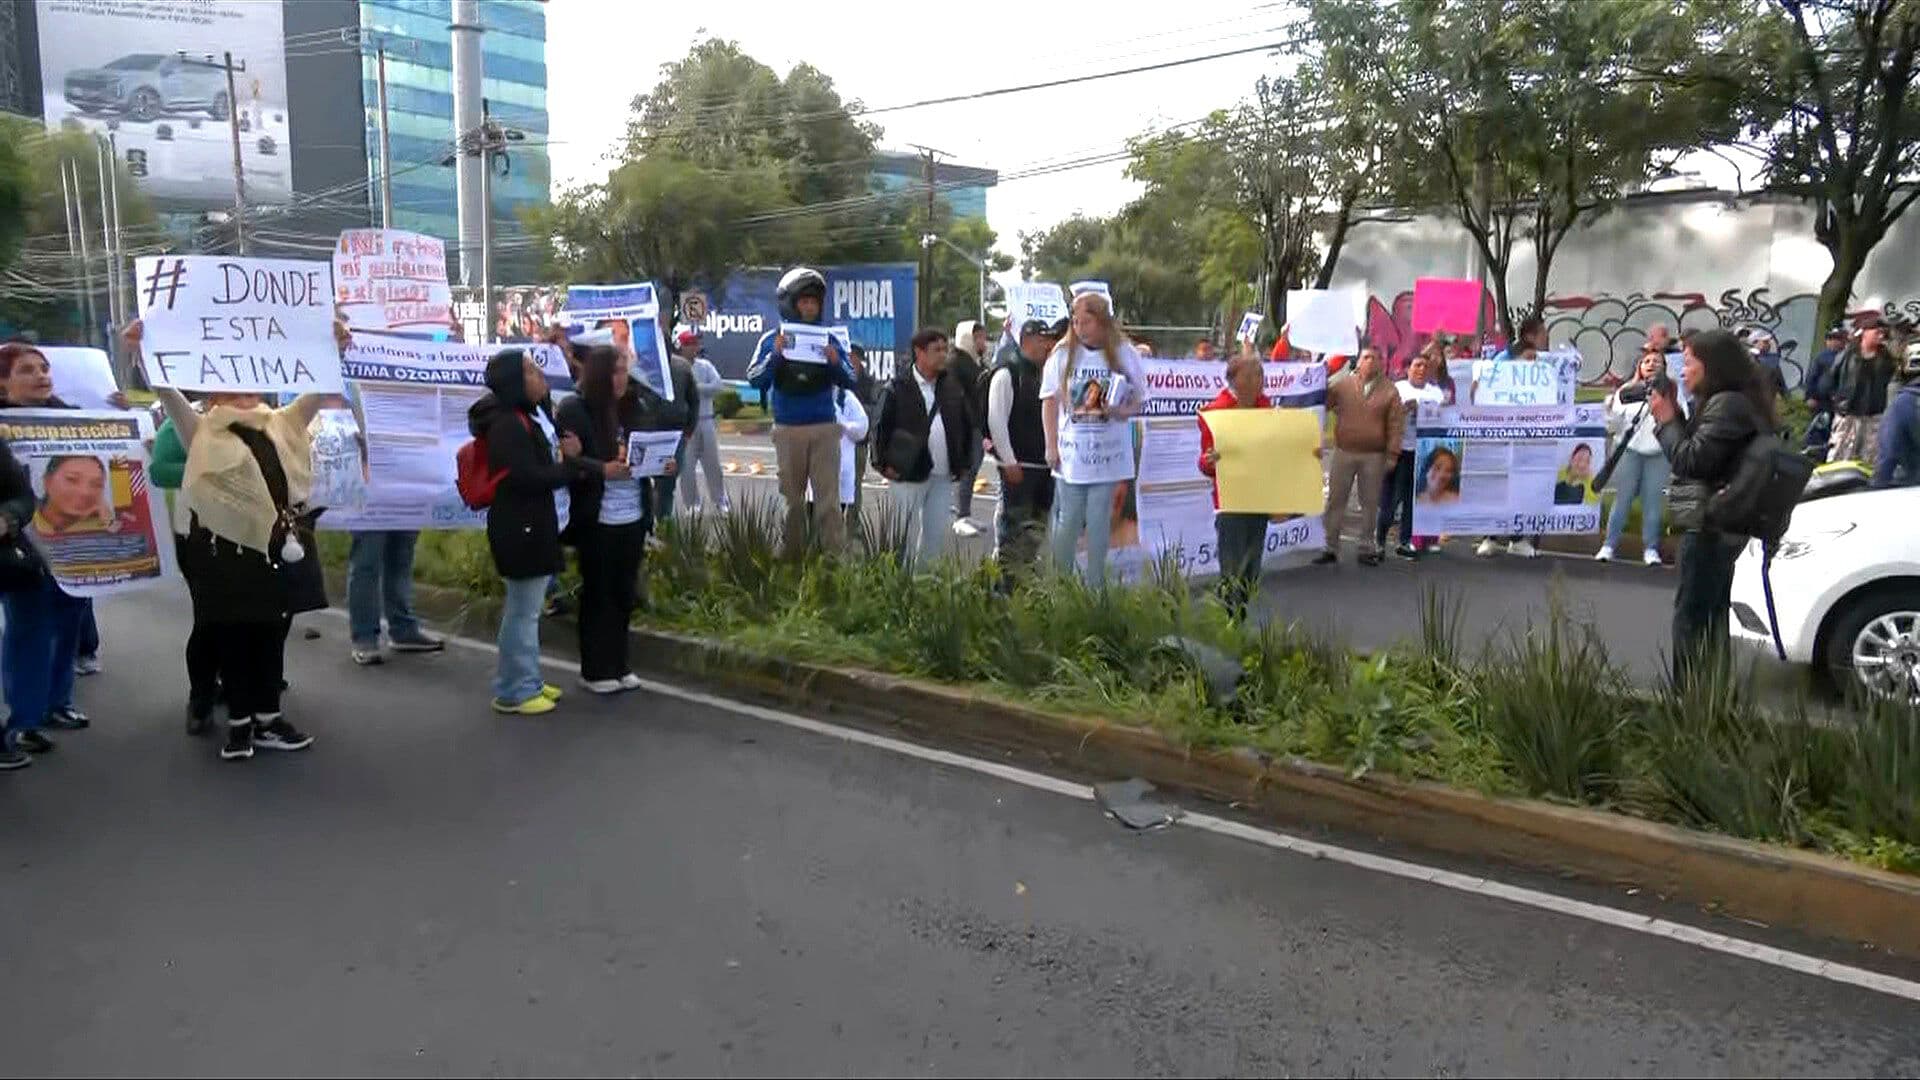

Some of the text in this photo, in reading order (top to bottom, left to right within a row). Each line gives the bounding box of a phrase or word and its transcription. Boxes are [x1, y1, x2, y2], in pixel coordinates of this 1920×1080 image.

[143, 259, 187, 310] #
[213, 263, 325, 307] DONDE
[833, 279, 895, 318] PURA
[200, 316, 287, 342] ESTA
[153, 351, 316, 384] FATIMA
[394, 367, 461, 382] OZOARA
[1146, 368, 1211, 388] yudanos
